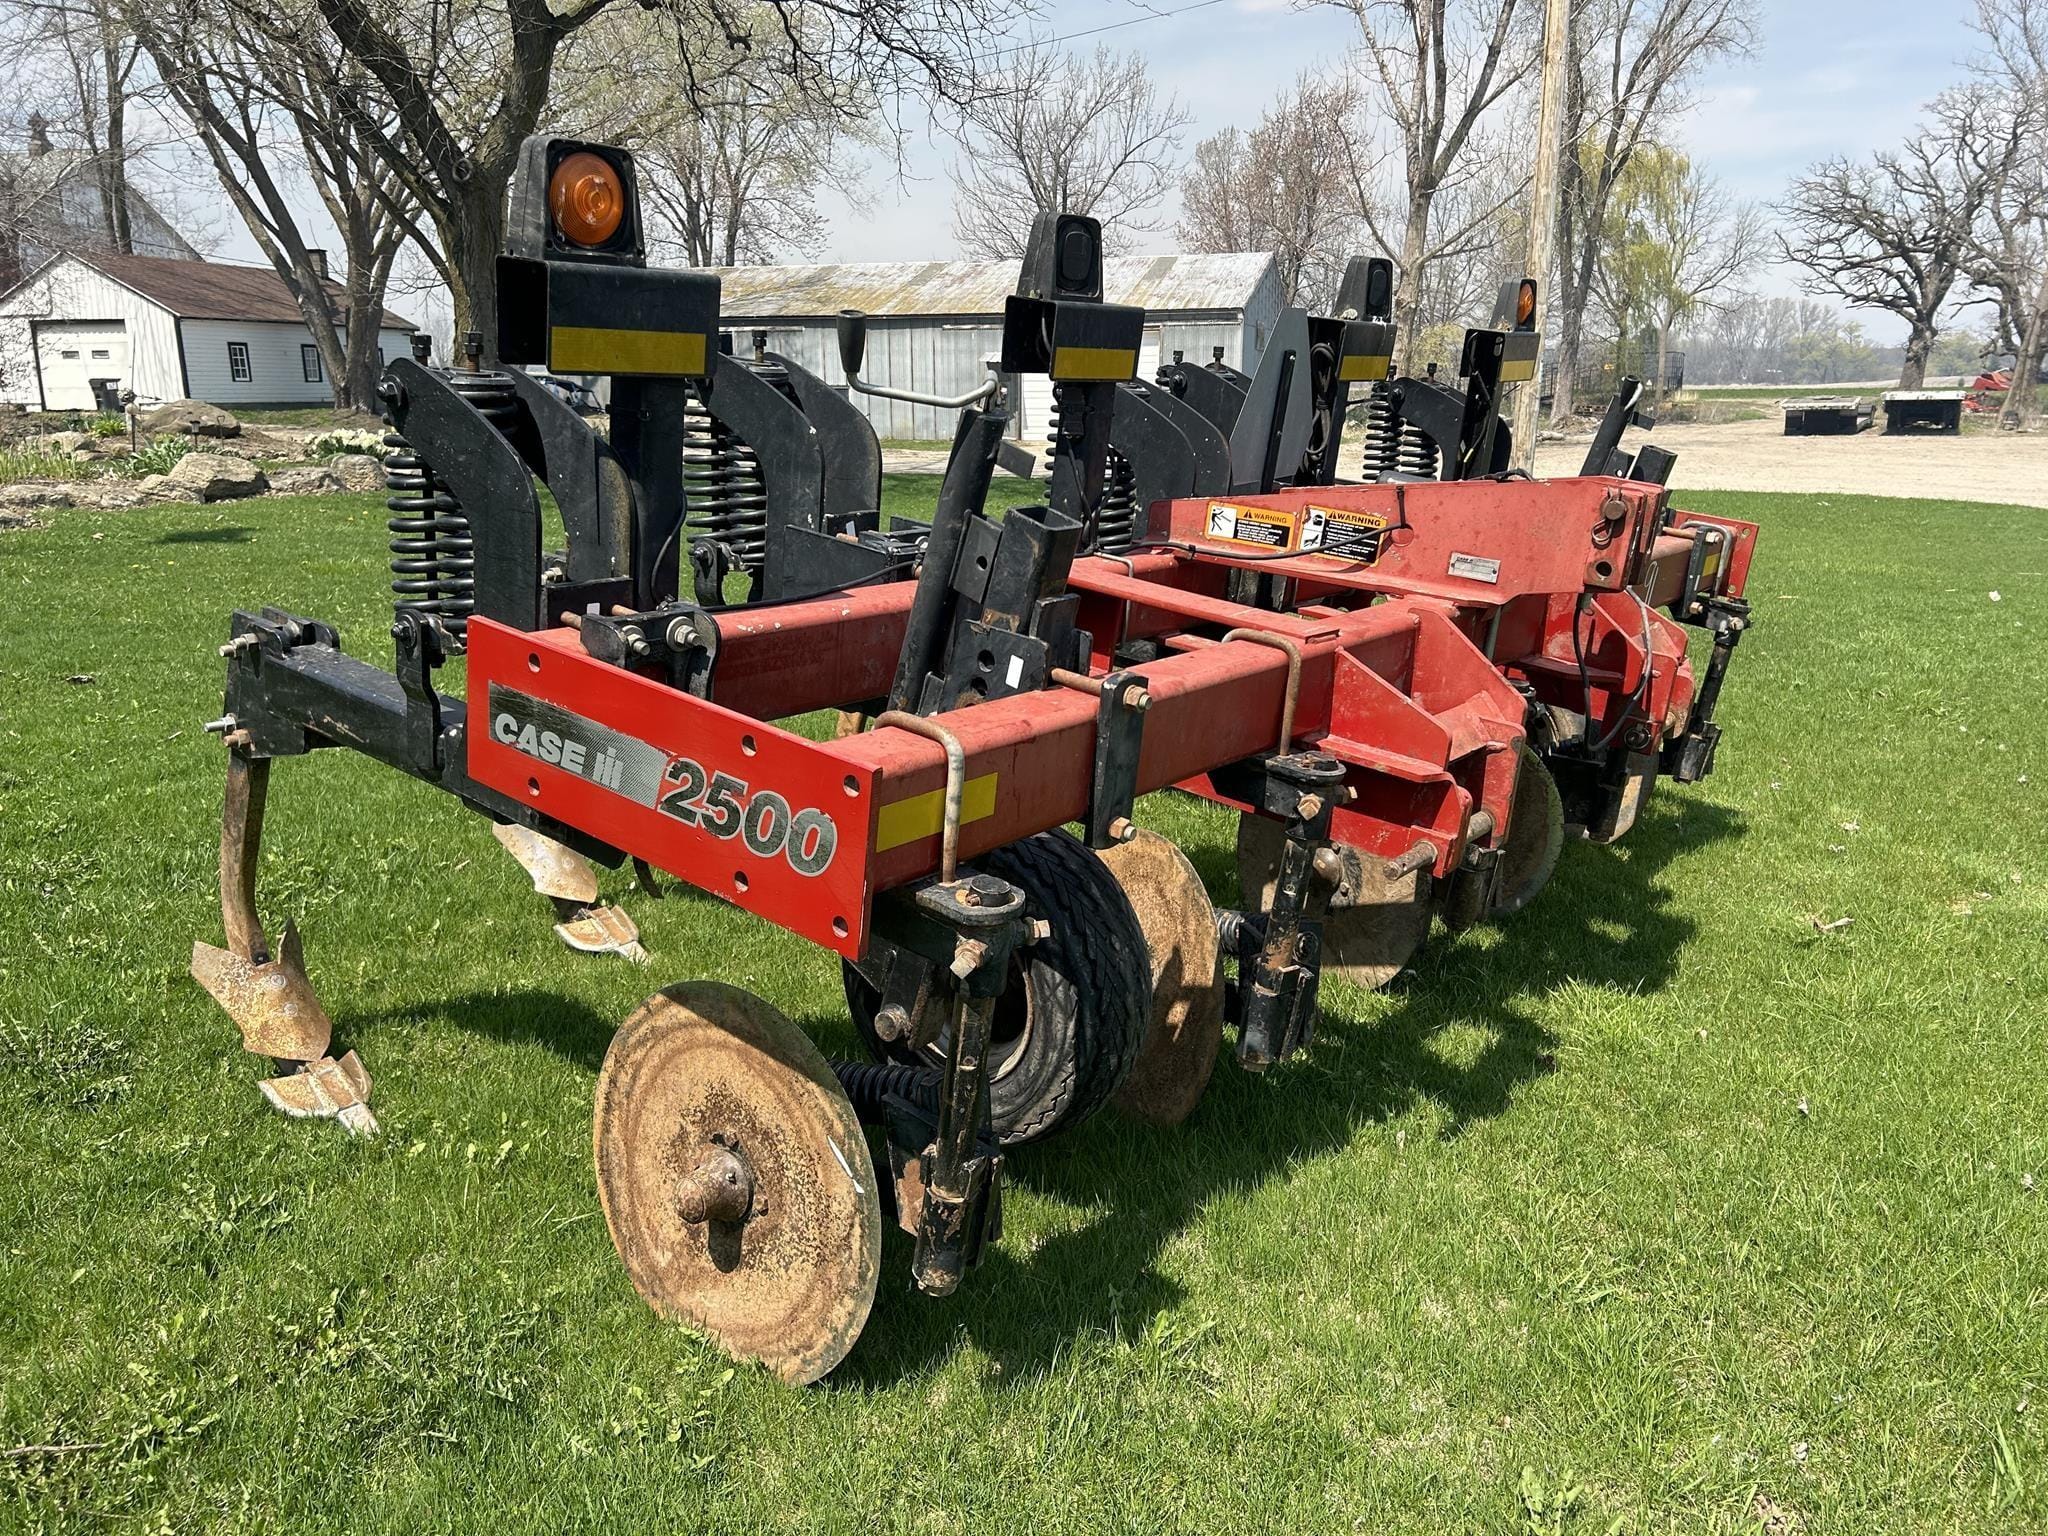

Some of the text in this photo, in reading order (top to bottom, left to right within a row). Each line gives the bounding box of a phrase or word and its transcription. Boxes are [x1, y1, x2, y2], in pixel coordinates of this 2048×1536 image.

[1254, 512, 1287, 524] WARNING
[1337, 512, 1381, 527] WARNING
[495, 713, 587, 774] CASE
[657, 757, 838, 878] 2500
